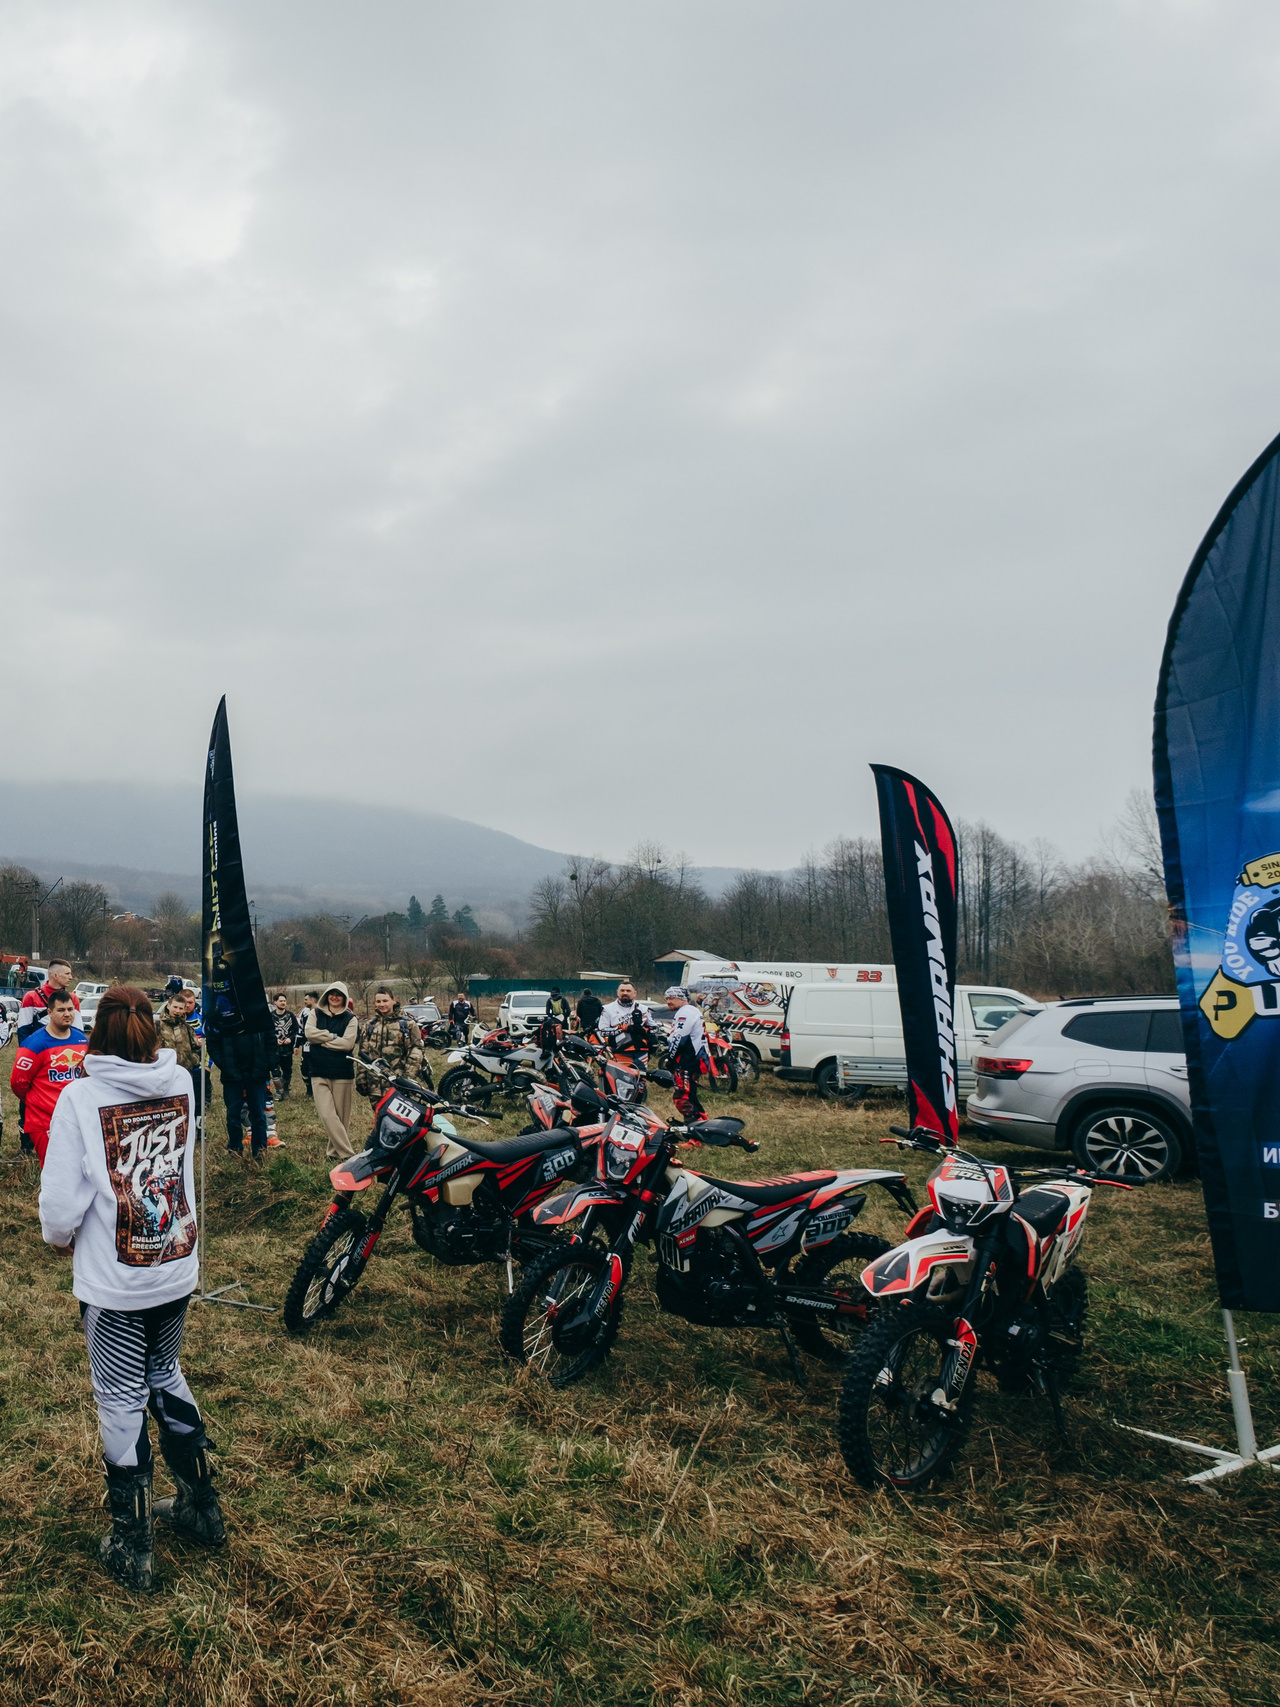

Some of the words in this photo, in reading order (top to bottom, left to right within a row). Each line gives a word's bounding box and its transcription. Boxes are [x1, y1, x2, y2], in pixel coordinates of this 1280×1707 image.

[856, 970, 882, 983] 33
[913, 840, 955, 1113] SHARMAX
[48, 1066, 73, 1082] Red
[395, 1102, 412, 1118] 111
[116, 1114, 187, 1176] JUST
[621, 1129, 628, 1140] 1
[131, 1146, 185, 1202] CAT
[424, 1154, 475, 1188] SHARMAX
[542, 1149, 576, 1177] 300
[668, 1187, 731, 1235] SHARMAX
[593, 1279, 616, 1318] KENDA
[785, 1295, 837, 1310] SHARMAX
[951, 1340, 975, 1391] KENDA
